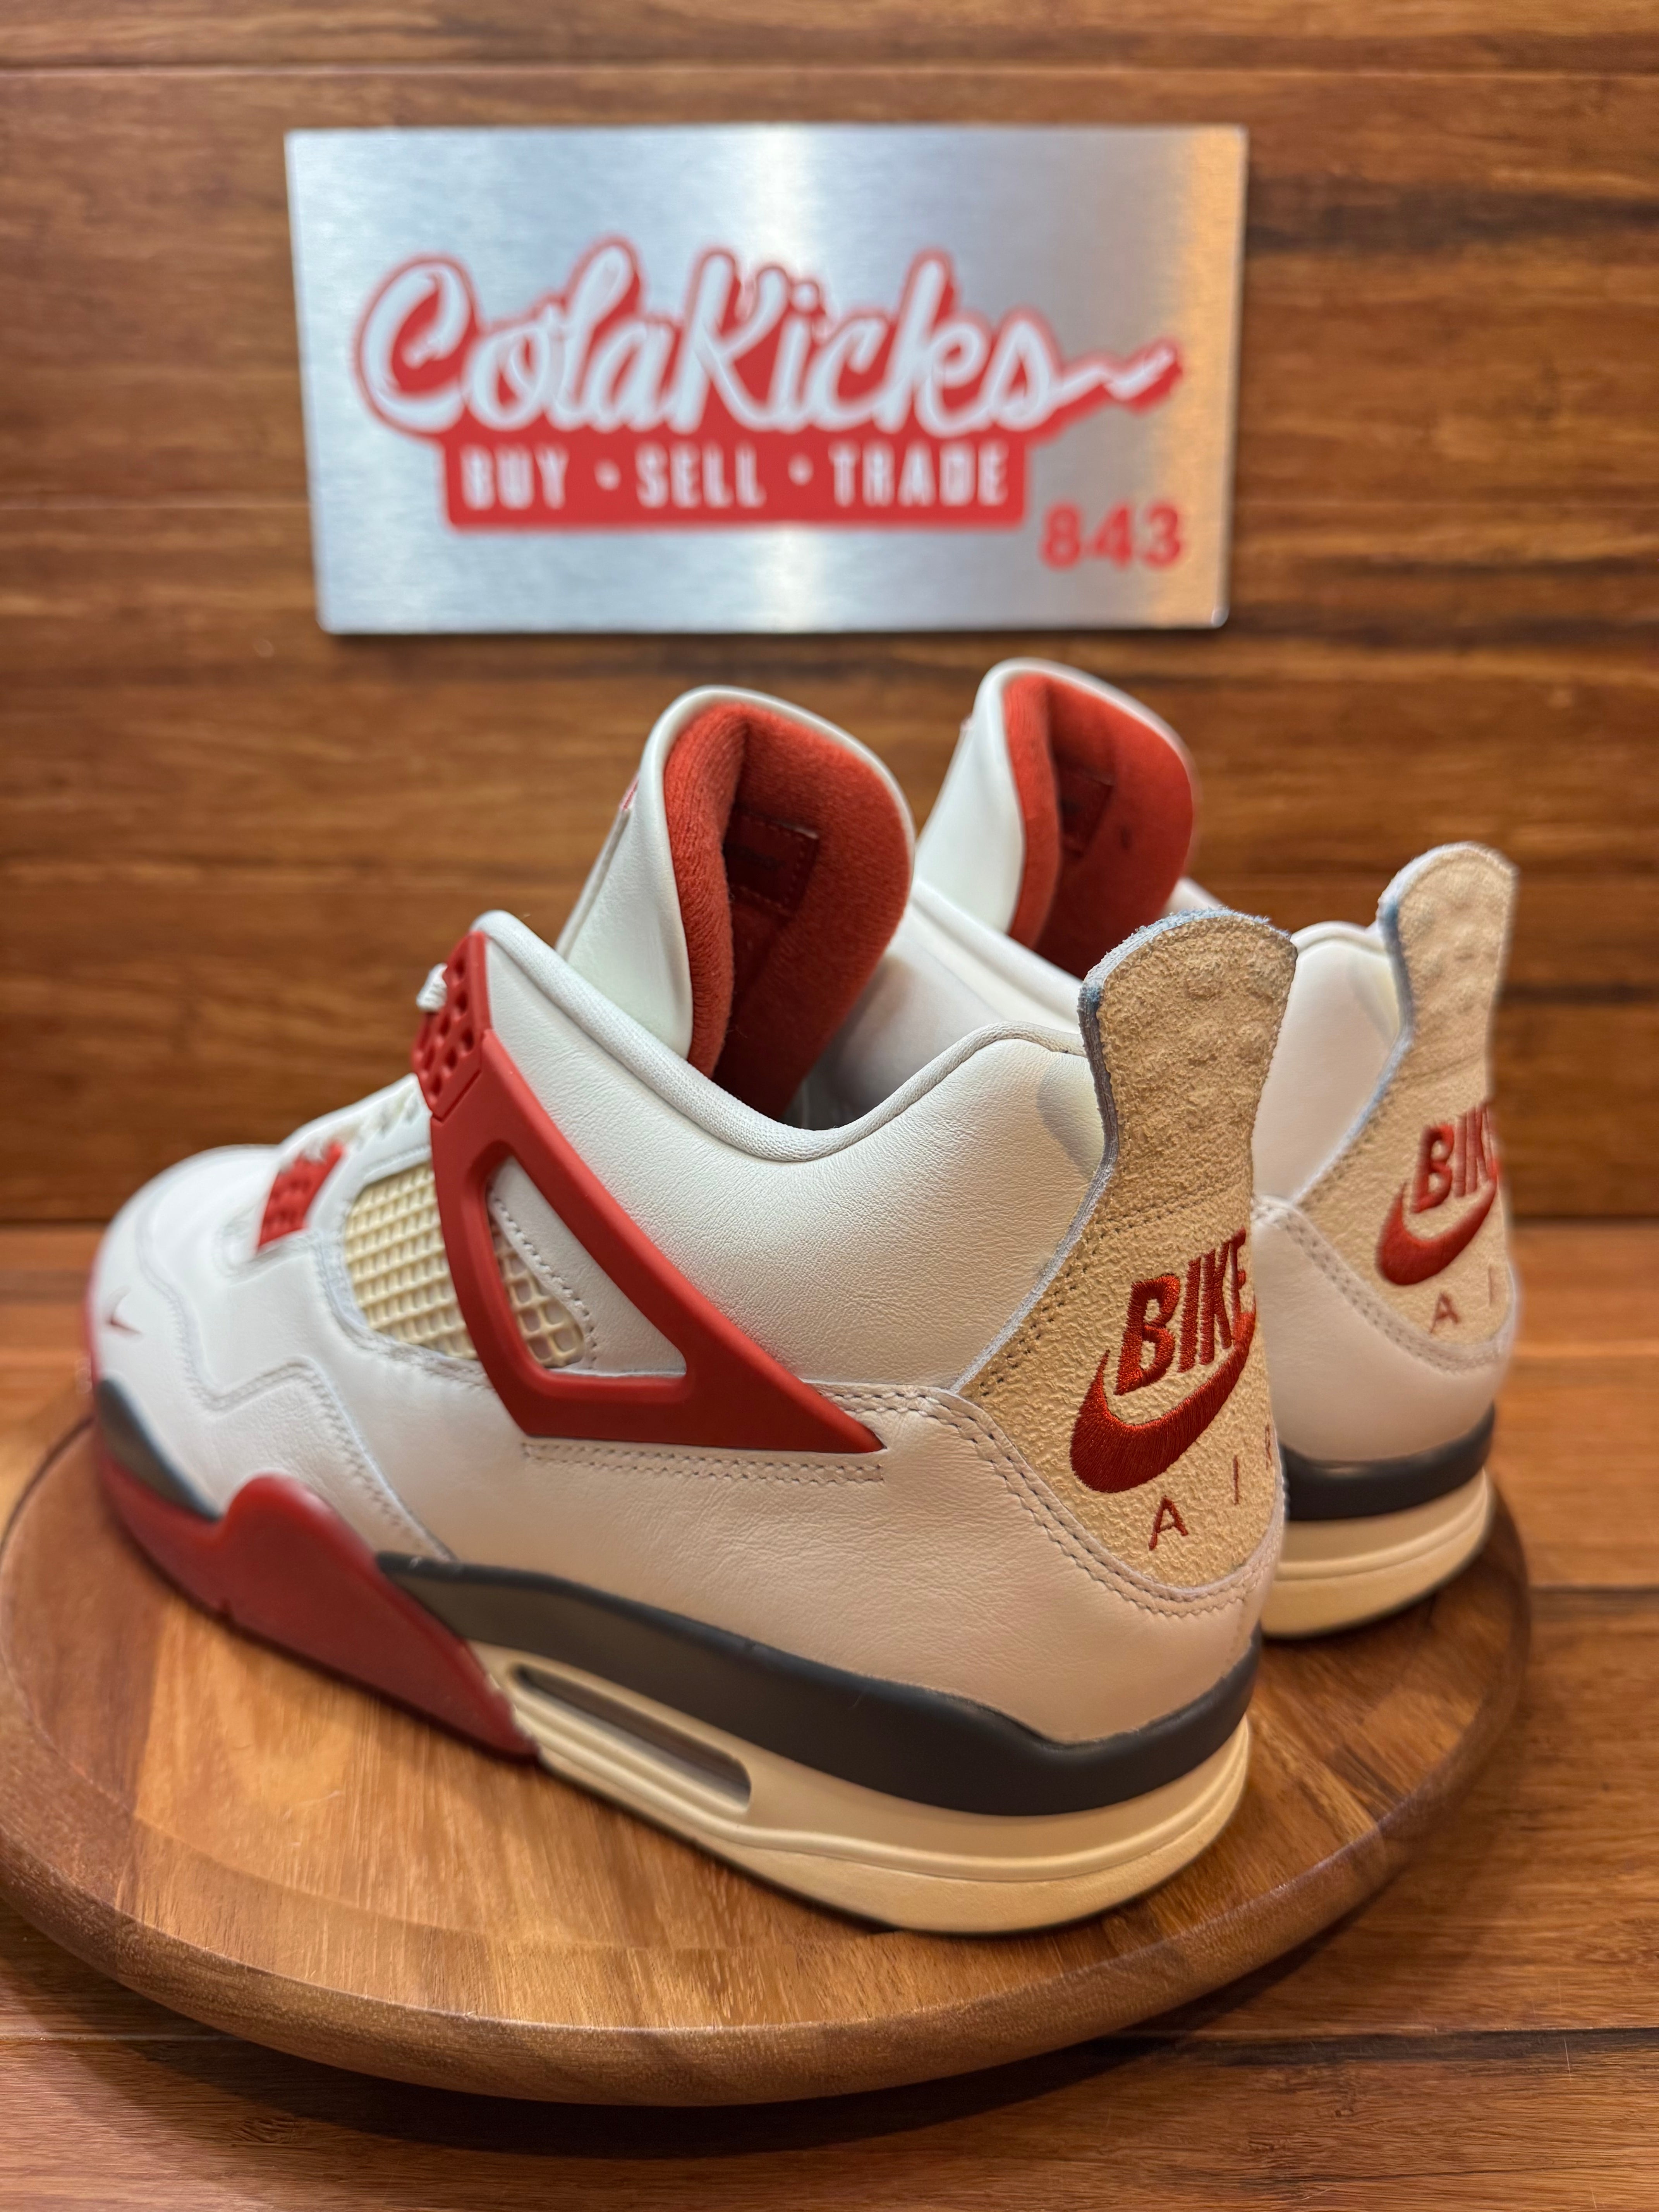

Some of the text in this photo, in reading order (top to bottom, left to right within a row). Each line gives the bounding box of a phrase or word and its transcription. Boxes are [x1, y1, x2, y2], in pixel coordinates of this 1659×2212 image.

[360, 241, 1177, 436] ColaKicks
[460, 439, 1008, 510] BUY SELL TRADE
[1042, 503, 1183, 571] 843
[1114, 1227, 1251, 1396] BIKE
